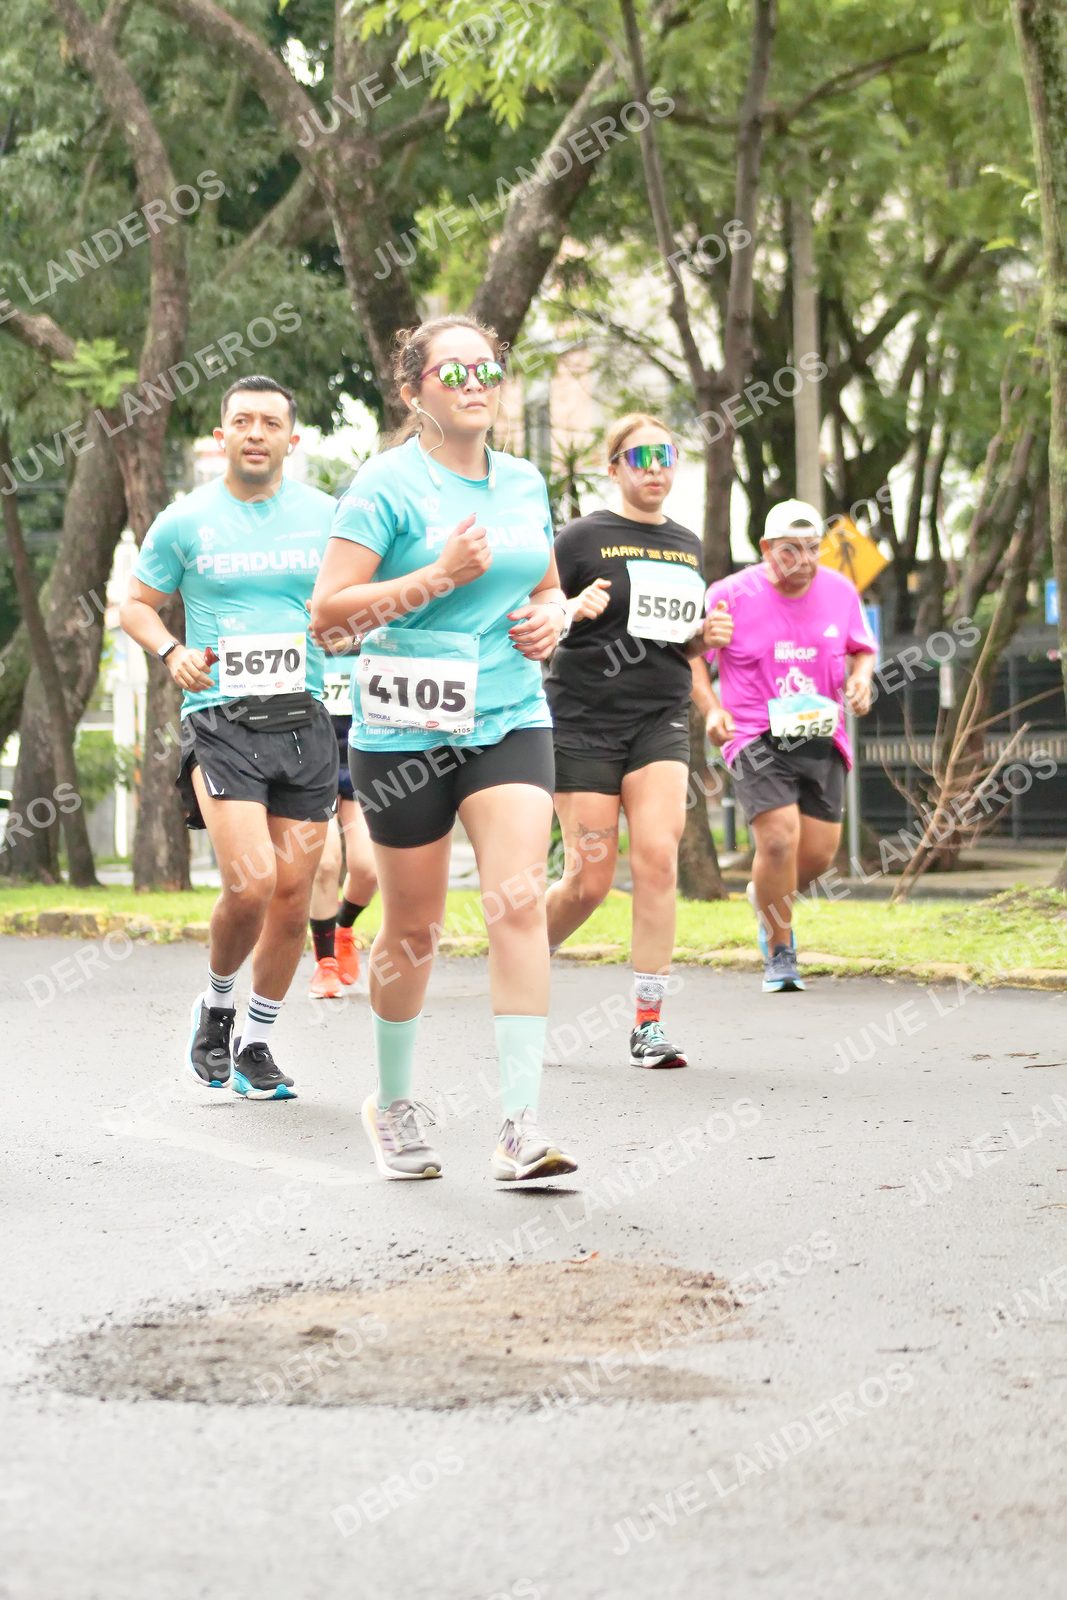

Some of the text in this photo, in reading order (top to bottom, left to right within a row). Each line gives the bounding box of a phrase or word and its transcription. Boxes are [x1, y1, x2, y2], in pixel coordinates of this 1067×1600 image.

[196, 547, 321, 575] PERDURA
[600, 545, 645, 559] HARRY
[637, 594, 697, 623] 5580
[225, 648, 301, 677] 5670
[368, 675, 466, 713] 4105
